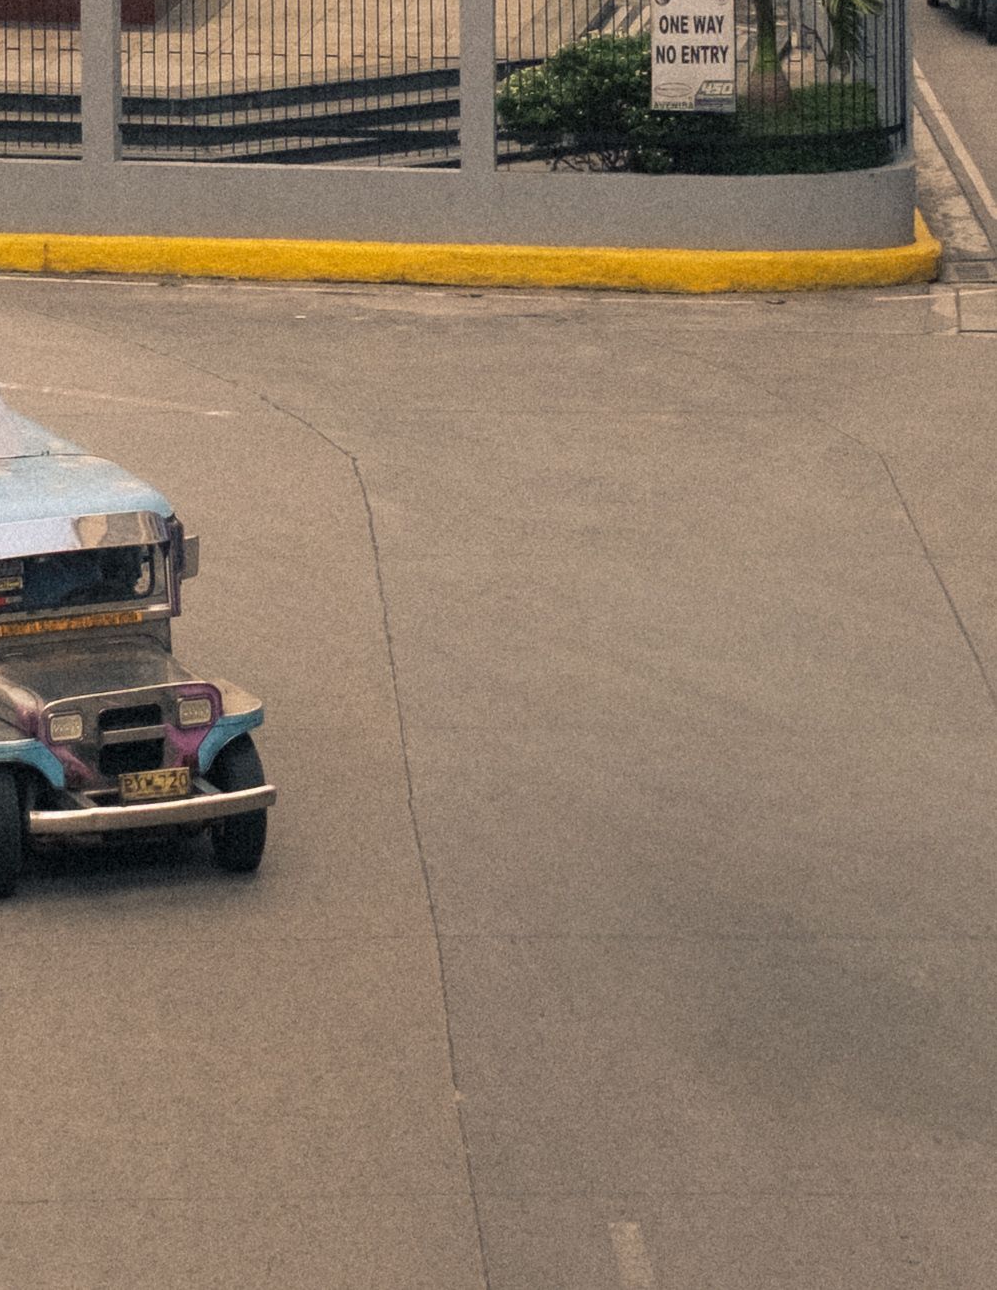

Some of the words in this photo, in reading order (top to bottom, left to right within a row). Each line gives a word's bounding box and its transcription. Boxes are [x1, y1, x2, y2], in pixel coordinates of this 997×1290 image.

[659, 15, 689, 34] ONE
[693, 15, 724, 34] WAY
[655, 45, 676, 64] NO
[681, 45, 729, 64] ENTRY
